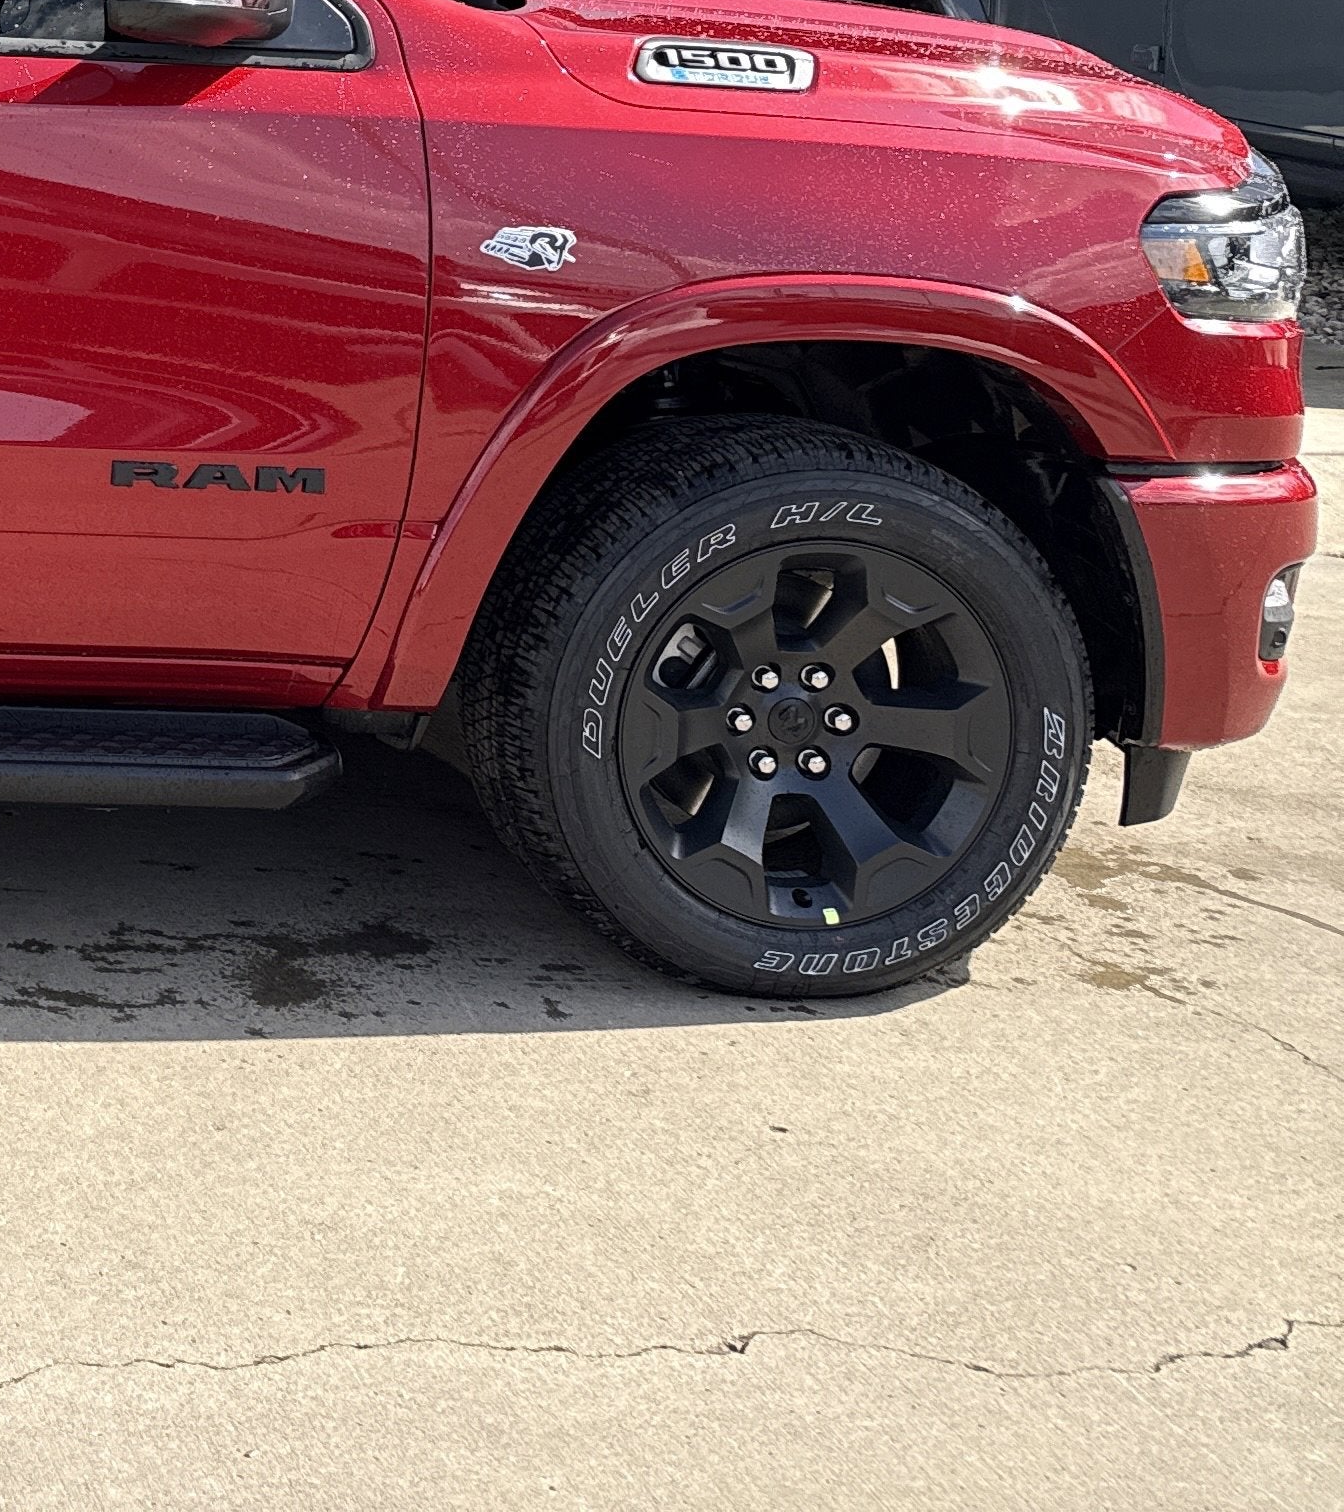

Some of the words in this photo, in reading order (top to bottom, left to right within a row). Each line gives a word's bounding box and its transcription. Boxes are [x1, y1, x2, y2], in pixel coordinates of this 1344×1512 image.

[662, 47, 789, 72] 1500
[111, 460, 326, 495] RAM
[582, 523, 736, 759] DUELER
[771, 501, 883, 529] H/L
[753, 706, 1065, 976] BRIDGESTONE
